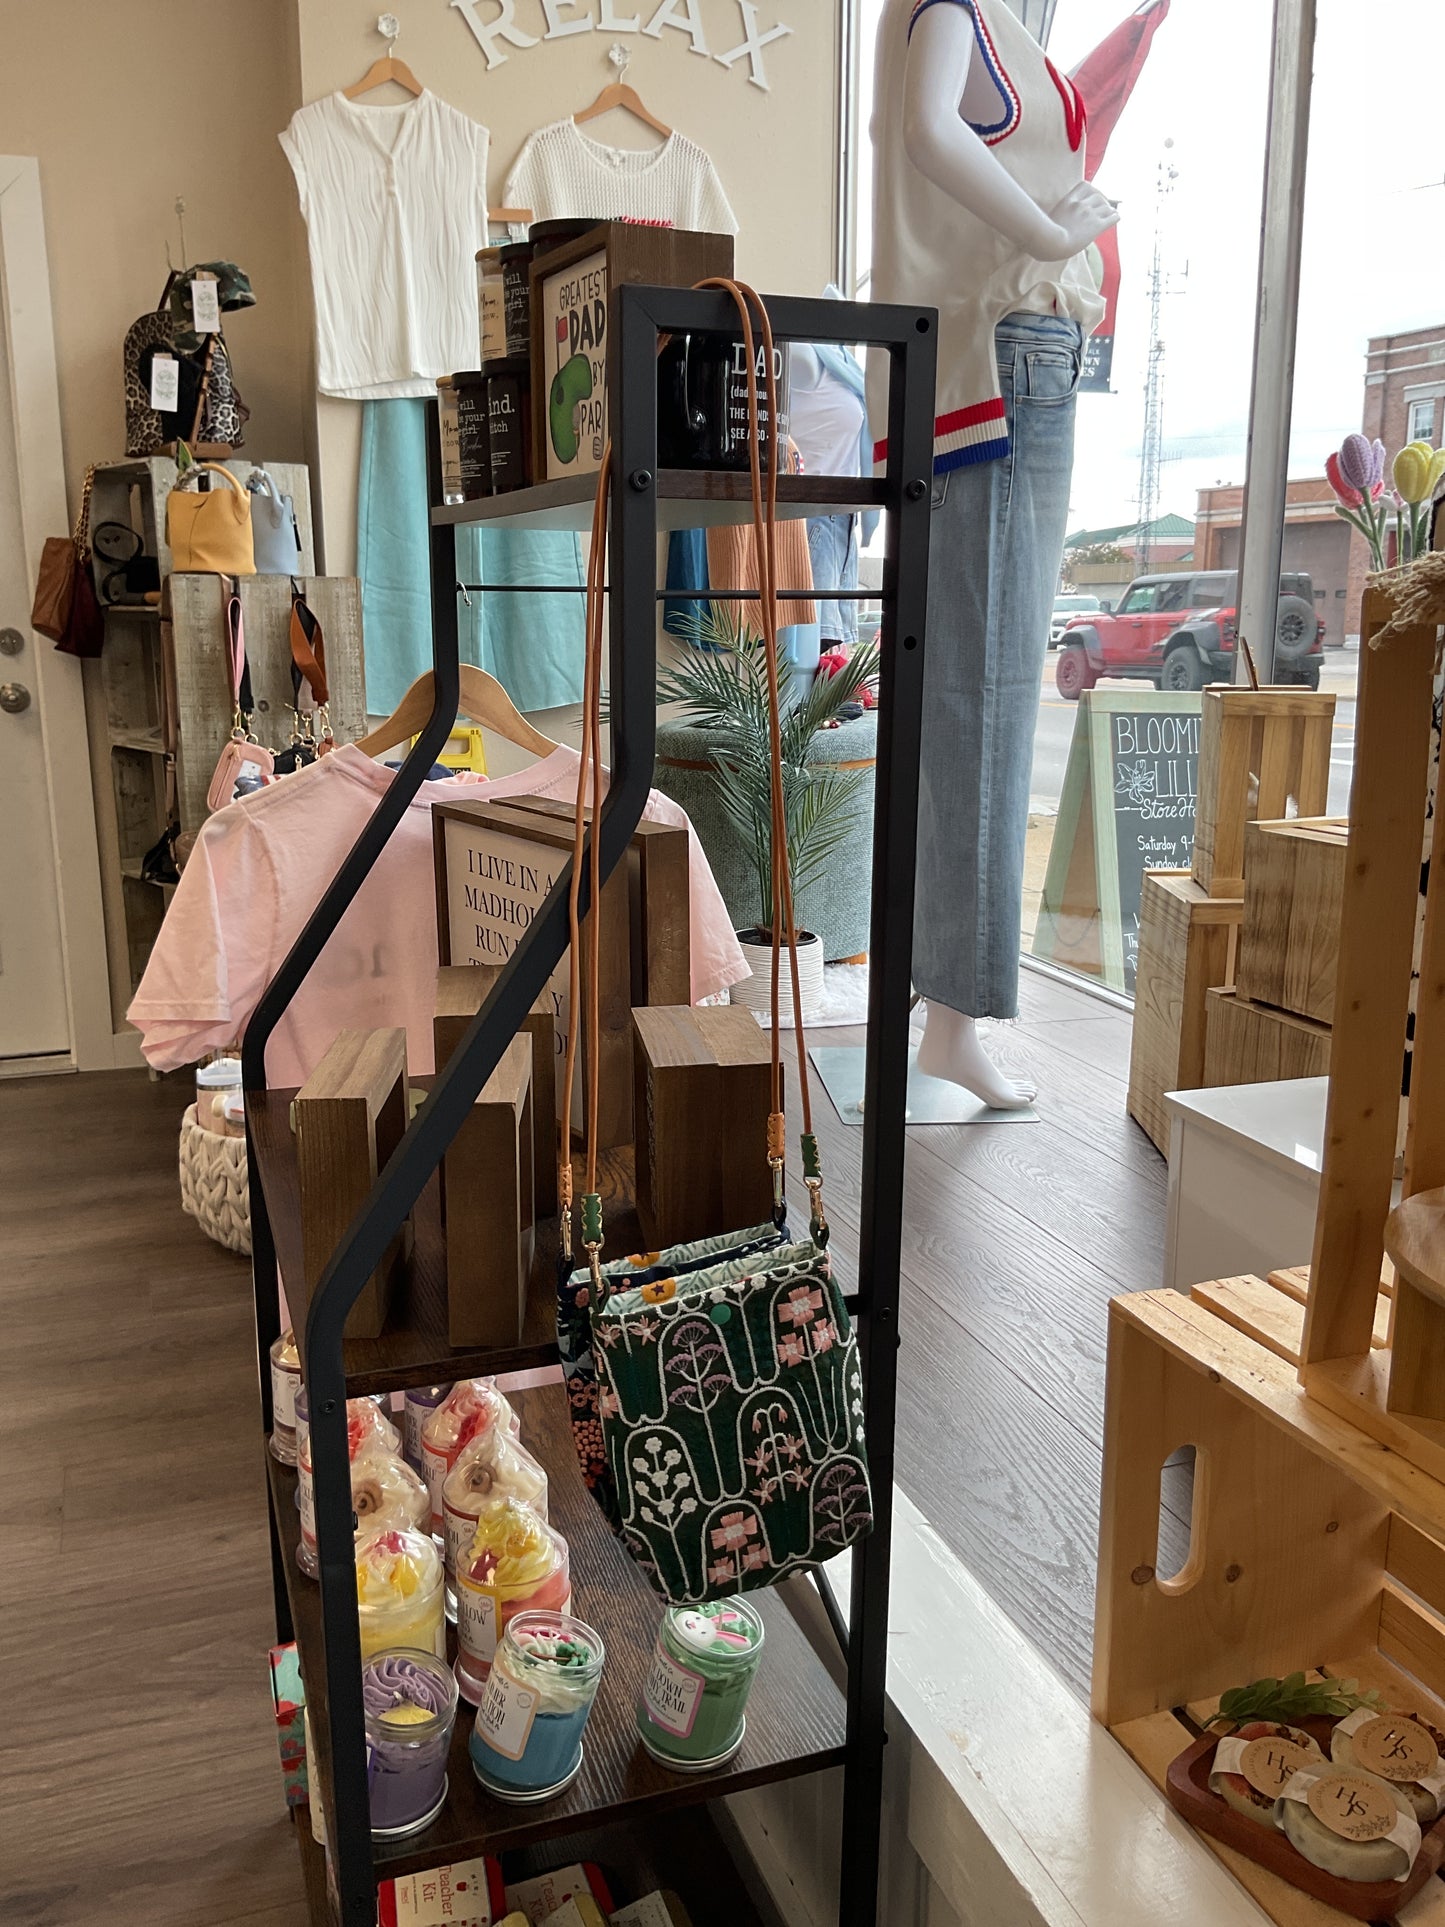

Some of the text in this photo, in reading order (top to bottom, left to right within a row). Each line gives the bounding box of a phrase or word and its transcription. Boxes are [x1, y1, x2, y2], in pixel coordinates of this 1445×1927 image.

[449, 0, 794, 92] RELAX
[560, 267, 608, 311] GREATEST
[569, 299, 606, 356] DAD
[593, 359, 605, 387] BY
[731, 343, 783, 380] DAD
[581, 400, 602, 437] PAR
[729, 407, 746, 420] THE
[730, 427, 746, 440] SEE
[1141, 798, 1177, 819] Store
[1137, 835, 1176, 855] Saturday
[468, 849, 553, 897] I LIVE IN A
[1144, 855, 1178, 869] Sunday
[475, 924, 509, 959] RUN
[656, 1668, 682, 1698] DOWN
[661, 1690, 686, 1714] TRAIL
[422, 1882, 438, 1903] Kit
[438, 1864, 455, 1916] Teacher
